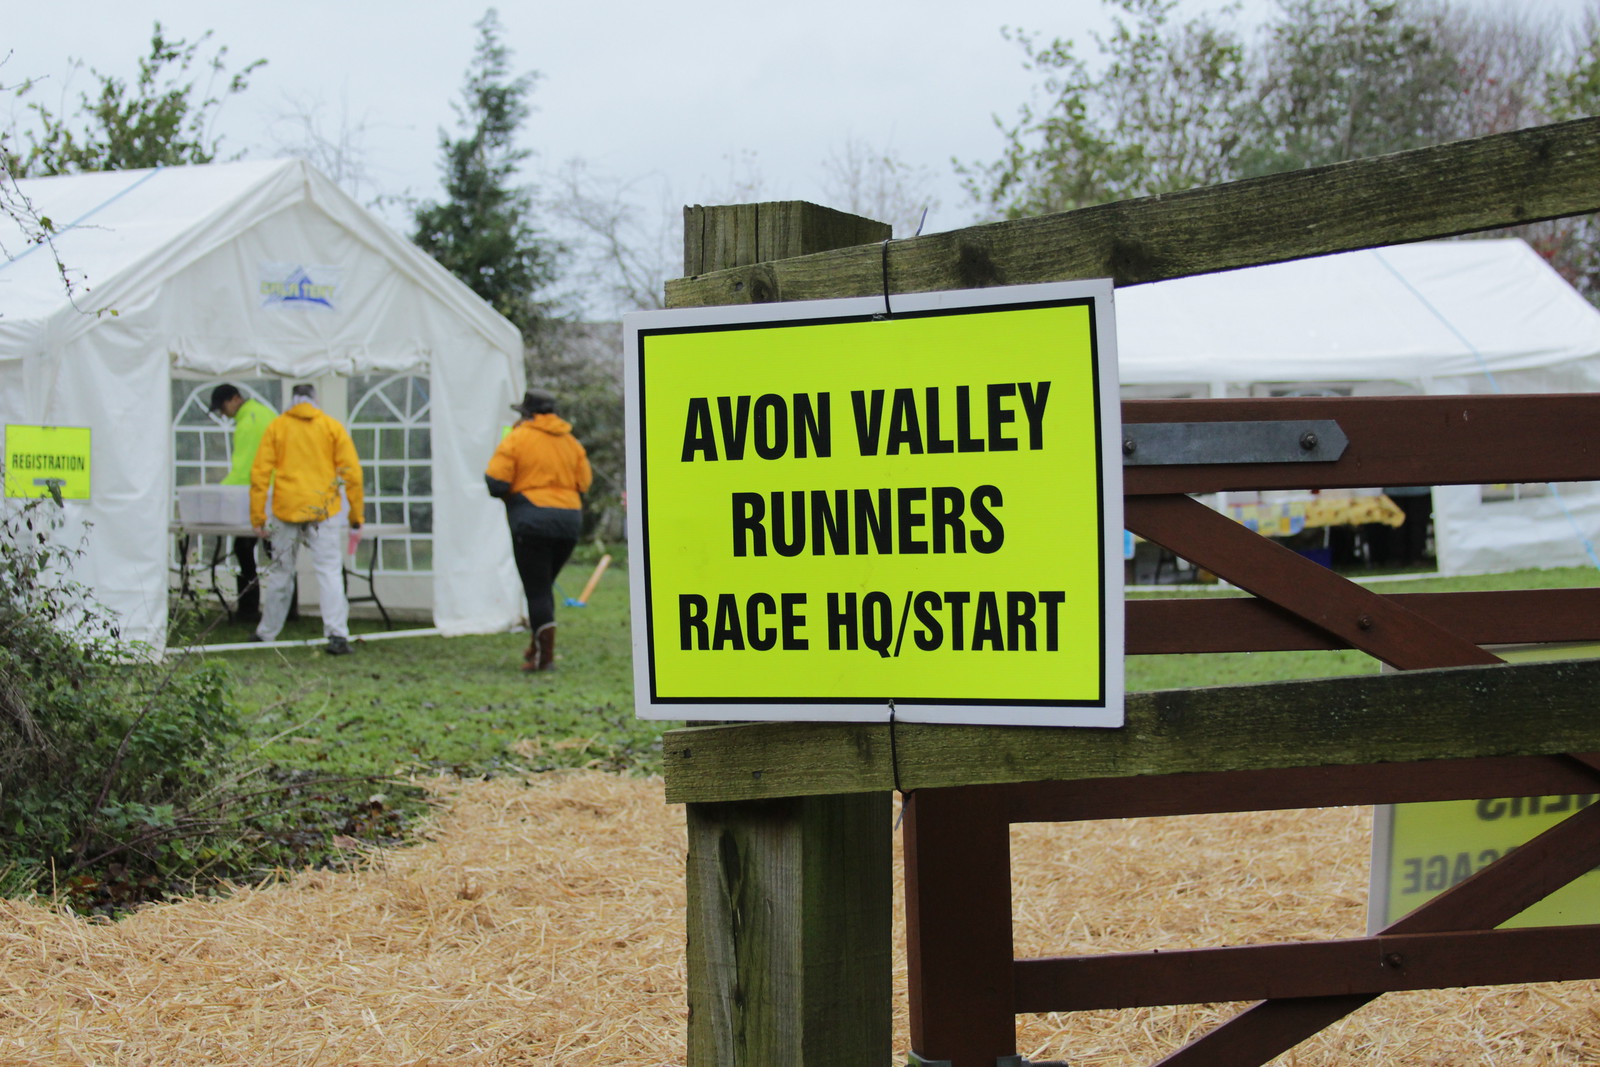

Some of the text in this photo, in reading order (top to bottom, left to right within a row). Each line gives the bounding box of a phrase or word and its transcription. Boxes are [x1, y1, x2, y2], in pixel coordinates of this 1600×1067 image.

[680, 381, 1052, 463] AVON VALLEY
[12, 453, 85, 471] REGISTRATION
[731, 484, 1005, 558] RUNNERS
[678, 590, 1066, 659] RACE HQ/START
